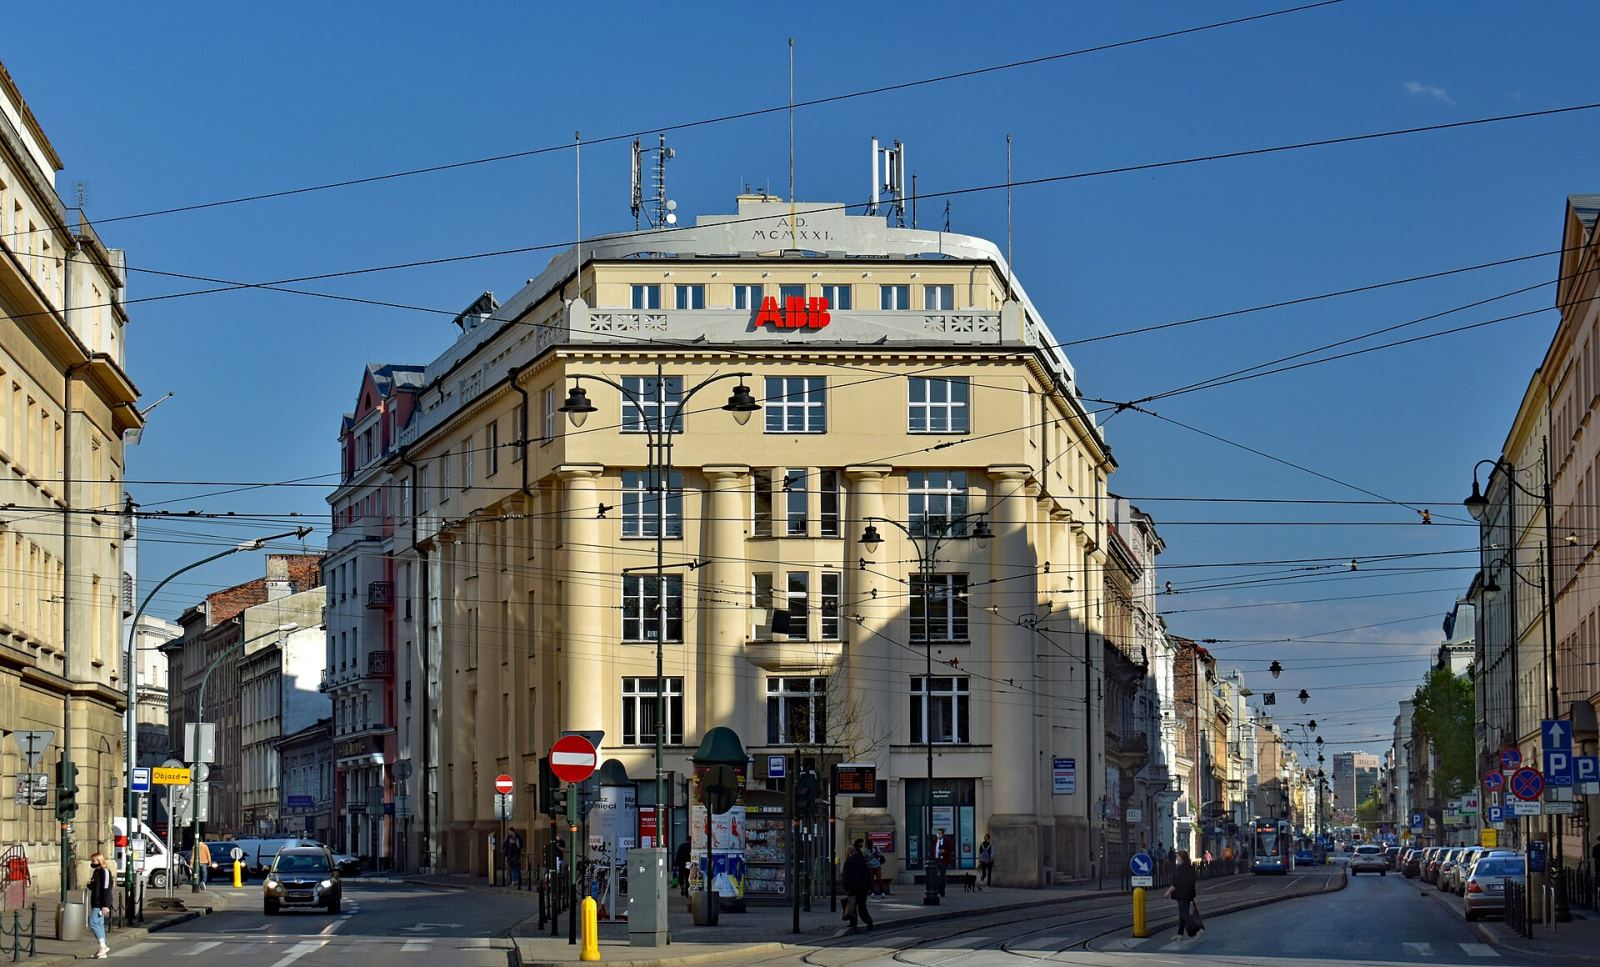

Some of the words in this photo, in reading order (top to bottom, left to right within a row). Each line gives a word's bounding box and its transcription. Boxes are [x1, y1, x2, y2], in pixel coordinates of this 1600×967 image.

[754, 296, 831, 329] ABB
[1549, 753, 1567, 776] P
[1578, 758, 1594, 780] P
[154, 771, 181, 781] Objazd
[1491, 808, 1501, 821] P
